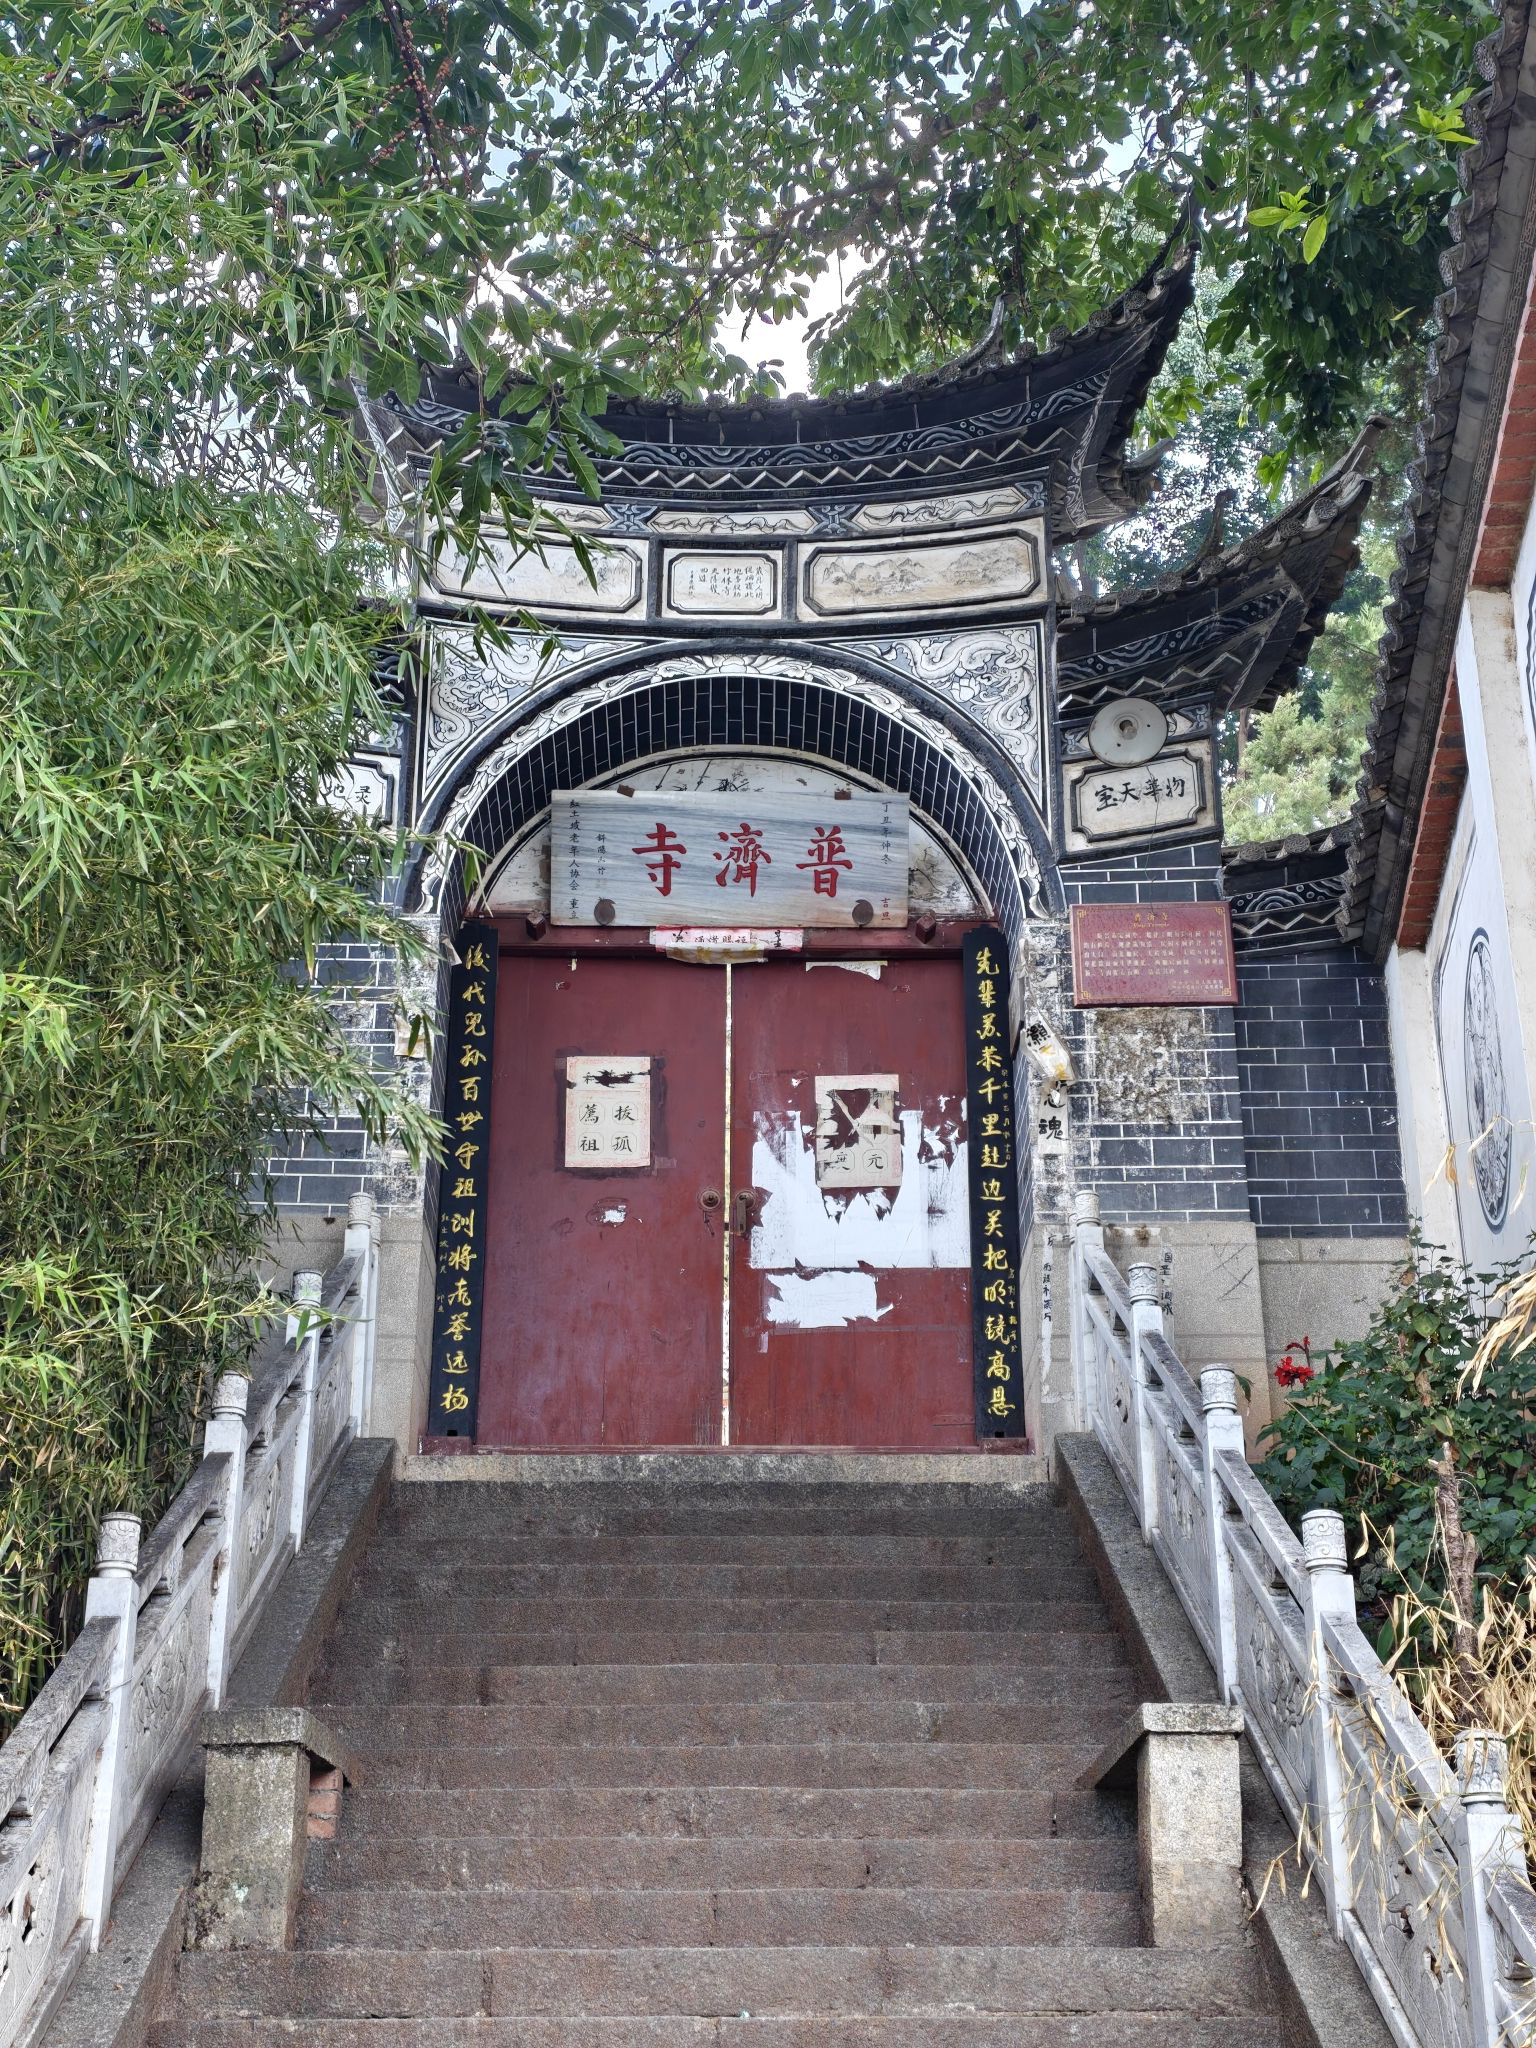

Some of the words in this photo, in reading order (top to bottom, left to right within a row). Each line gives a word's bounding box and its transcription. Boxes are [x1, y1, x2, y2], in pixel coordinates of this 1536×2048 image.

[631, 822, 854, 898] 普濟寺
[867, 1153, 885, 1171] 元
